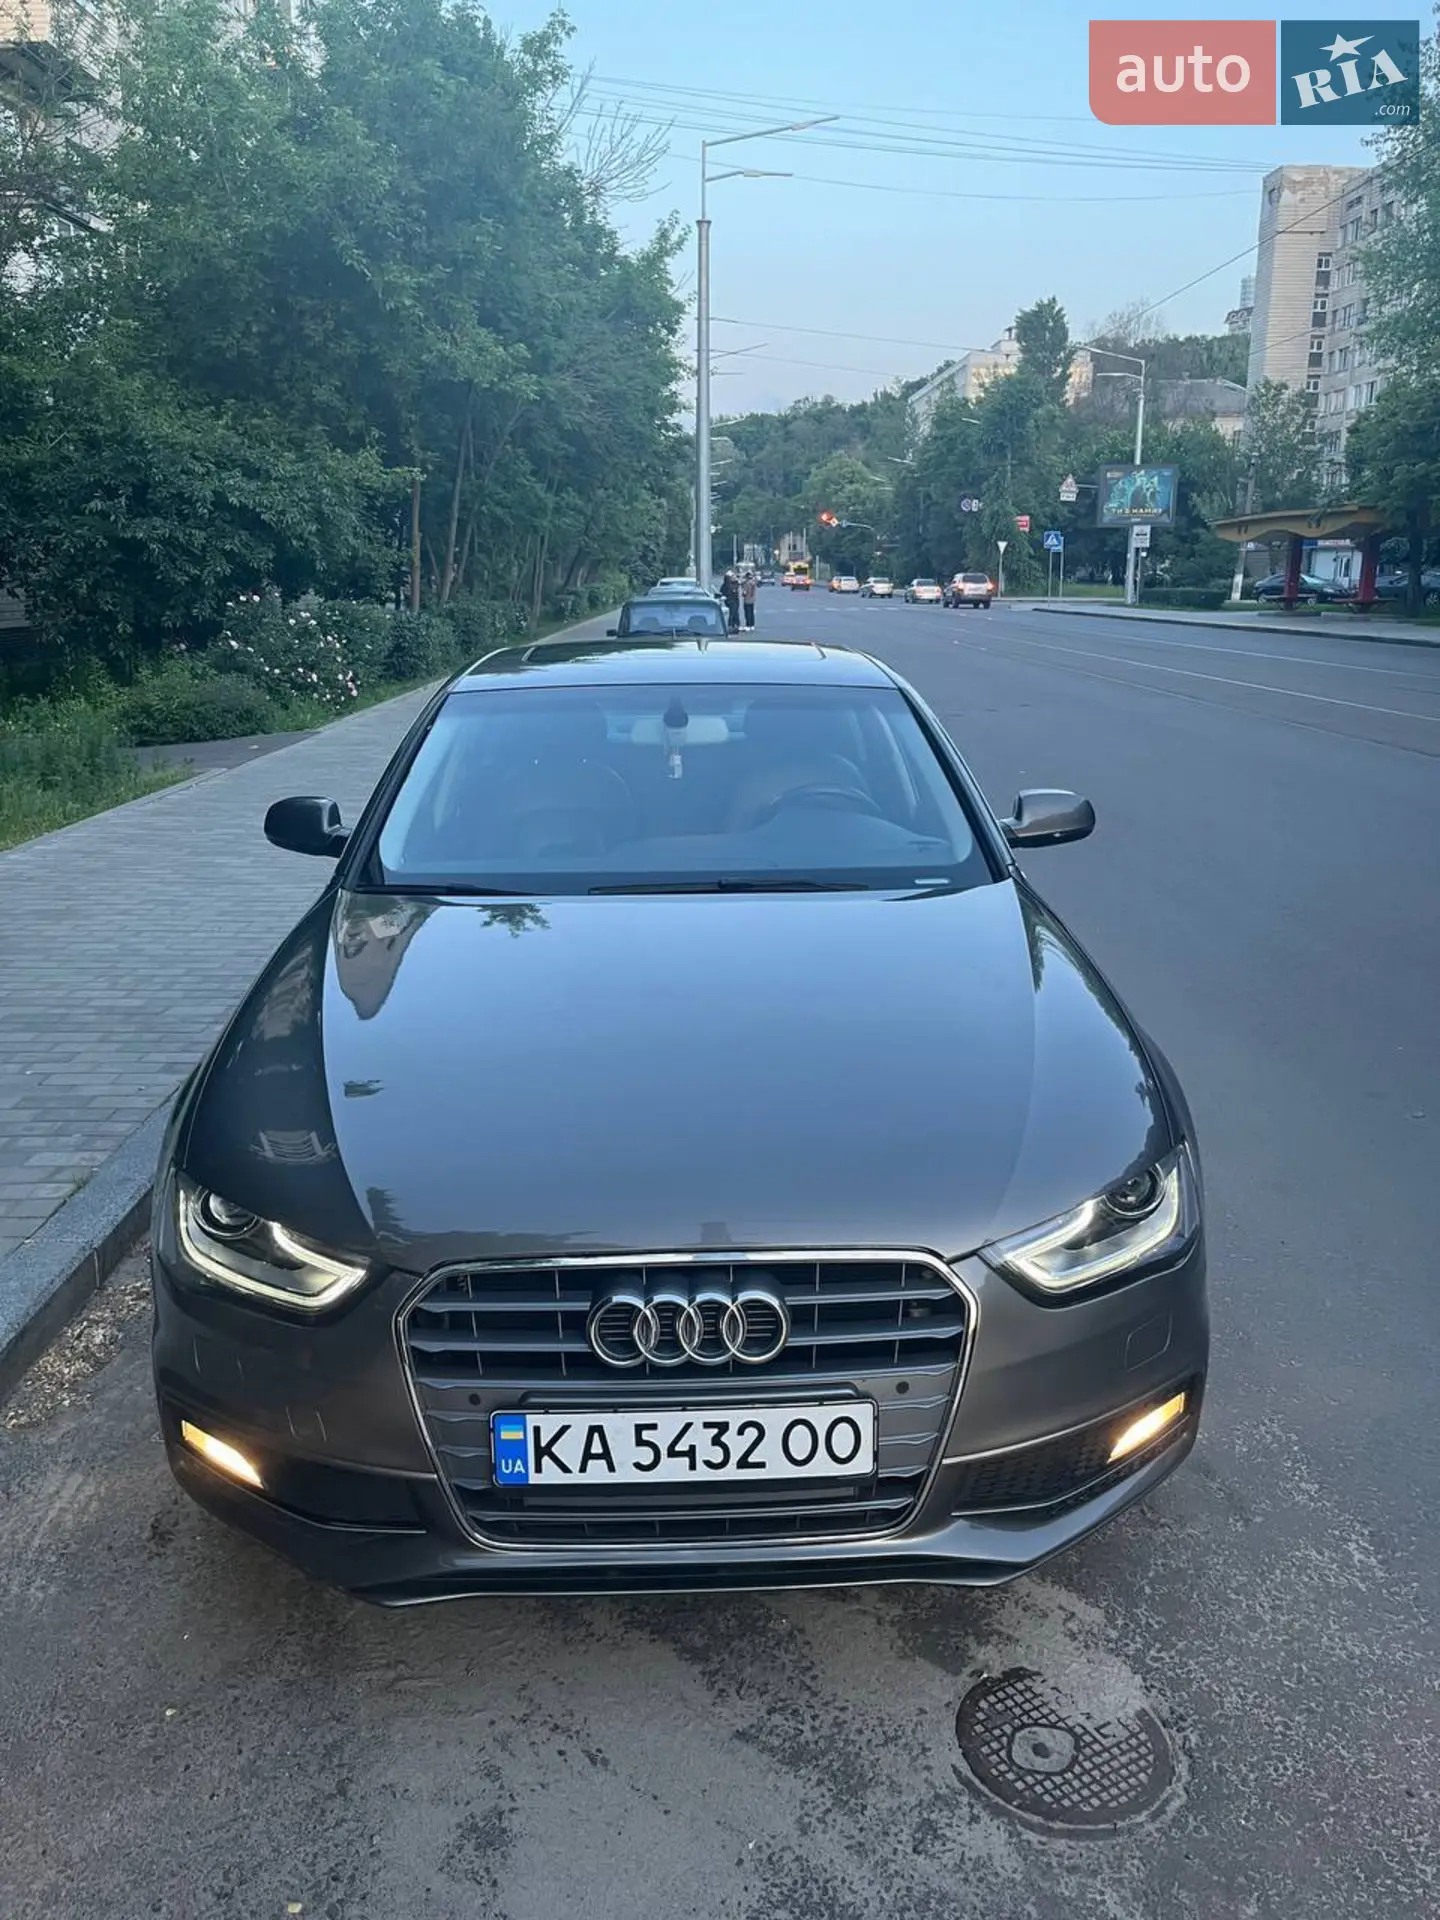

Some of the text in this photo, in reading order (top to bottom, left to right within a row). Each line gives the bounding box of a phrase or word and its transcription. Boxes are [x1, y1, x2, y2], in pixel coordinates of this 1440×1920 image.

[532, 1424, 616, 1474] KA
[633, 1421, 767, 1472] 5432
[501, 1459, 526, 1475] UA
